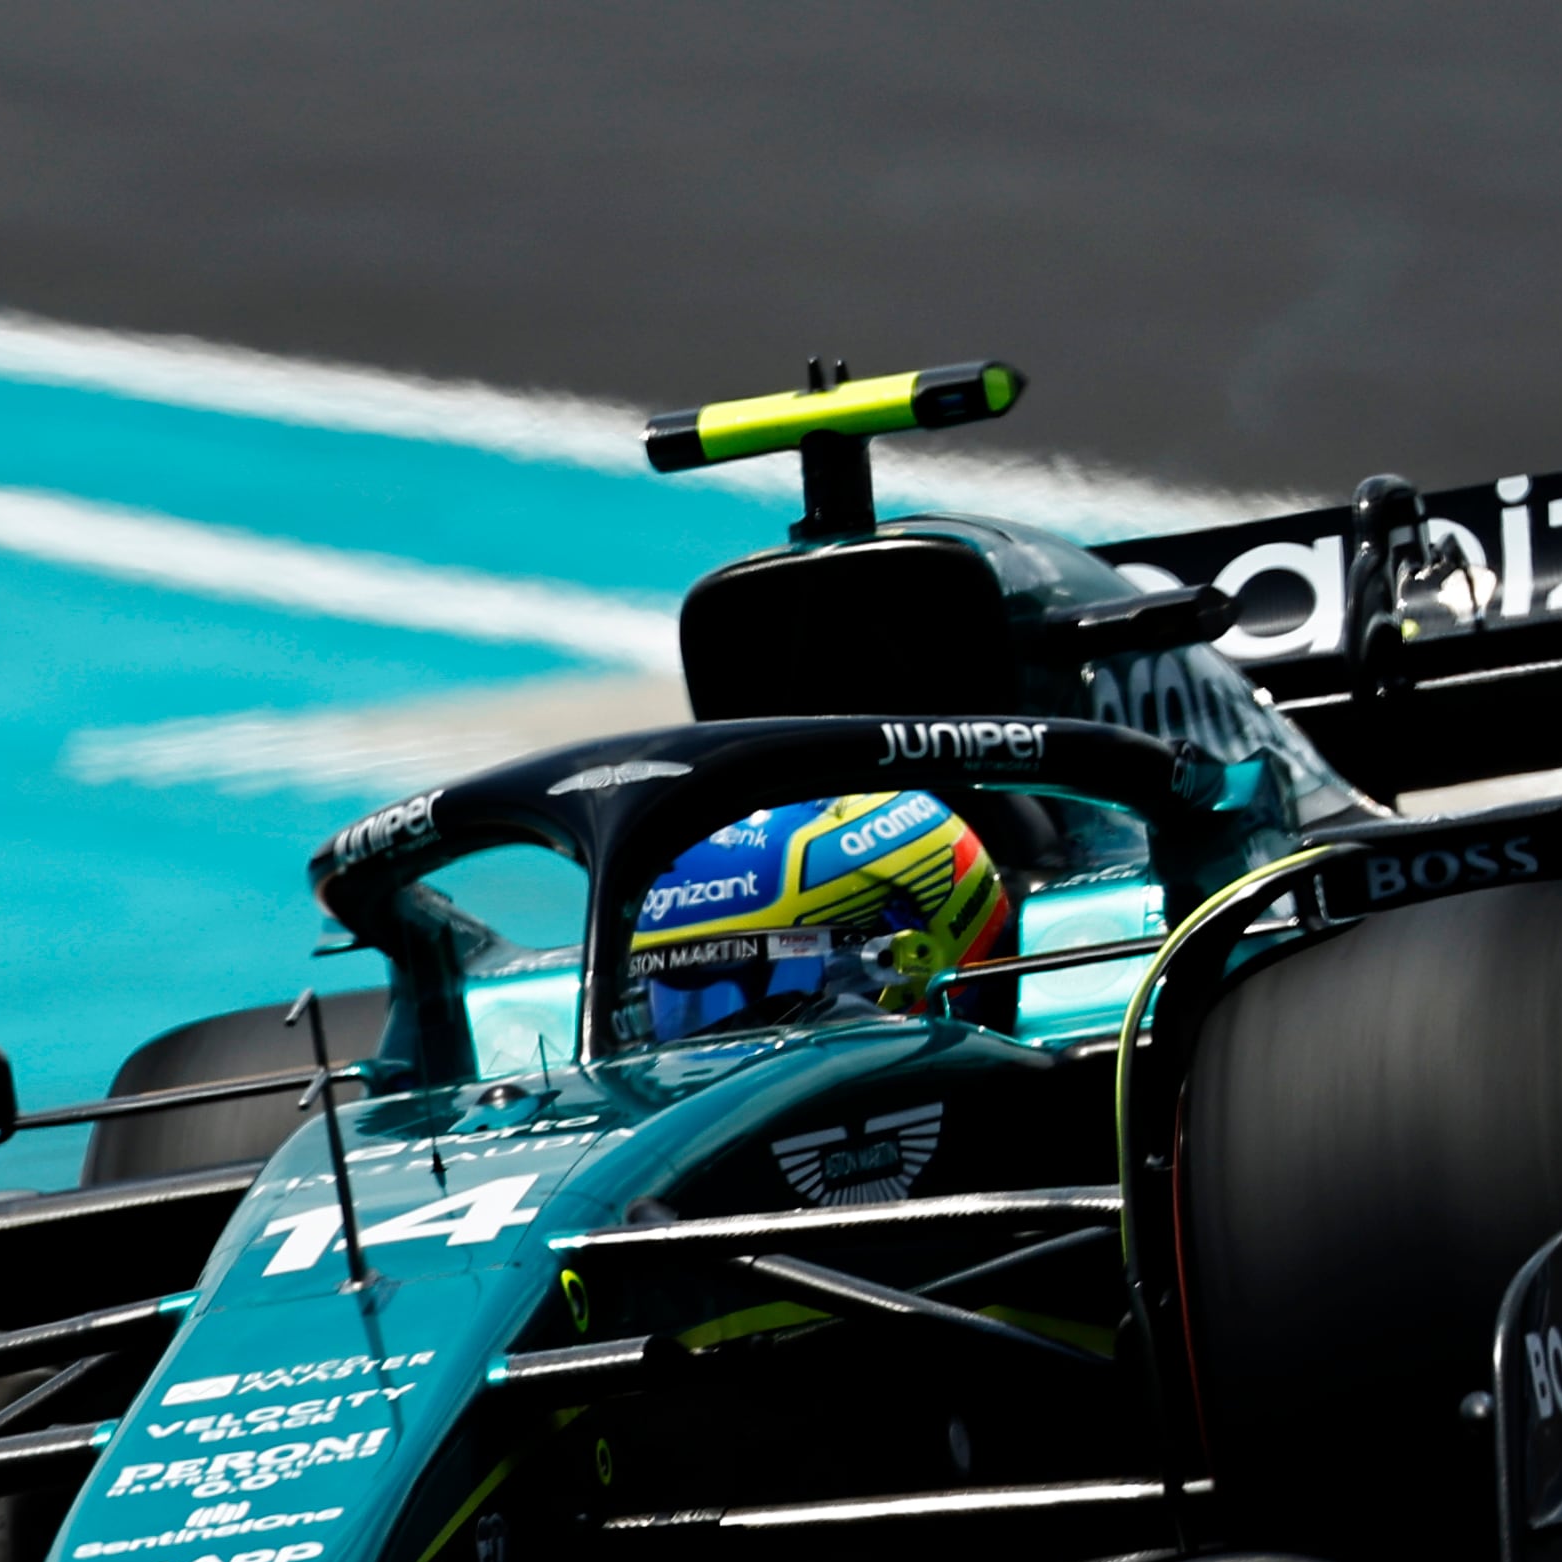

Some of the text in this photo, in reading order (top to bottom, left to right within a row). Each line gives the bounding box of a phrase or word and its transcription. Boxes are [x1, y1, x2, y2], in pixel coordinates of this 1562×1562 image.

[840, 794, 944, 857] aramco
[1365, 832, 1540, 902] BOSS
[641, 869, 760, 922] ognizant
[669, 937, 759, 970] MARTIN
[261, 1173, 540, 1279] 14
[236, 1350, 437, 1396] MASTER
[147, 1382, 418, 1439] VELOCITY
[198, 1410, 336, 1444] BLACK
[113, 1427, 392, 1489] PERONI
[72, 1507, 345, 1560] SentinelOne
